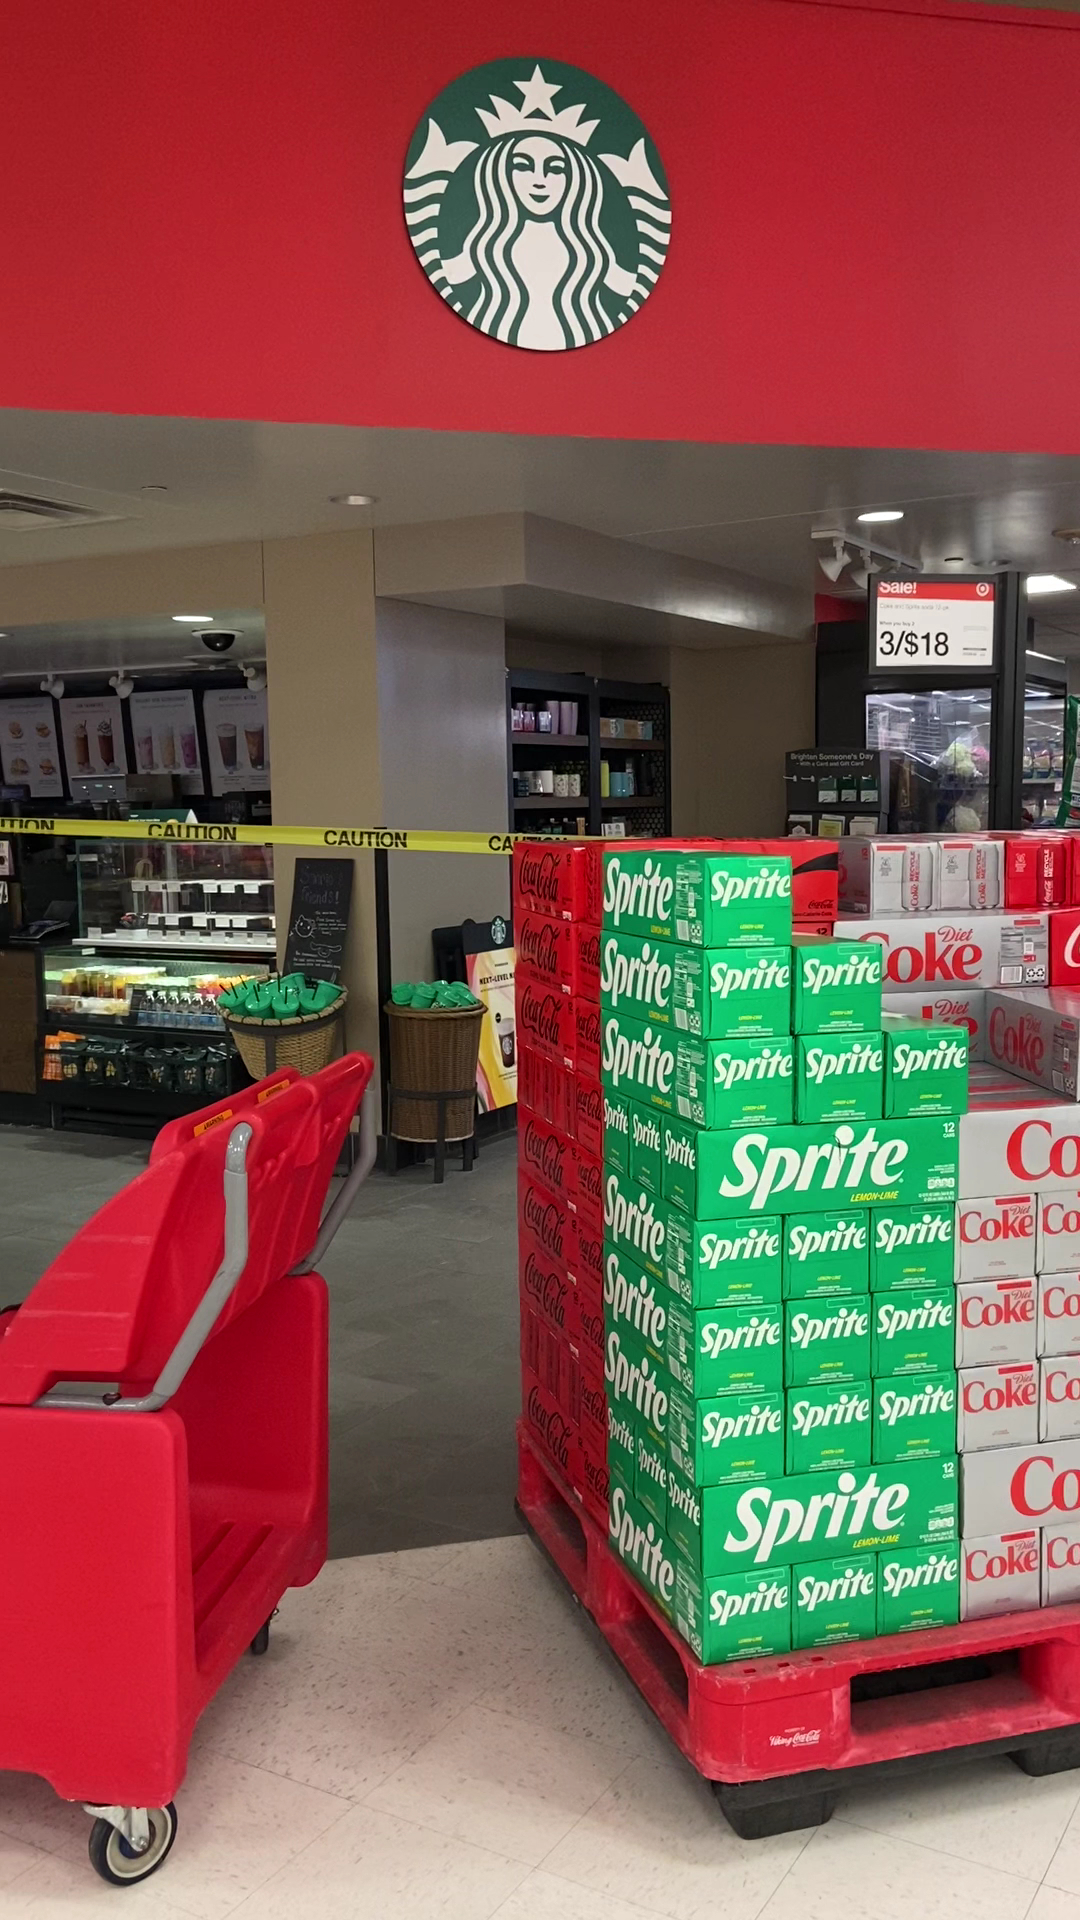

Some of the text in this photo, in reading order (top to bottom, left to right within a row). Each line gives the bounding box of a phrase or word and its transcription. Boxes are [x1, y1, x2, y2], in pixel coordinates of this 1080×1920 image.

[880, 582, 916, 594] Sale!
[880, 630, 949, 657] 3/$18
[148, 824, 236, 840] CAUTION
[324, 830, 407, 848] CAUTION
[603, 858, 673, 926] Sprite
[711, 868, 791, 907] Sprite
[938, 925, 974, 943] Diet
[480, 974, 508, 984] NEXT-LEVEL
[601, 938, 672, 1006] Sprite
[710, 958, 790, 998] Sprite
[803, 955, 880, 994] Sprite
[934, 999, 969, 1016] Diet
[1024, 1012, 1042, 1033] Diet
[602, 1018, 674, 1094] Sprite
[893, 1040, 966, 1079] Sprite
[988, 1006, 1044, 1077] Coke
[714, 1048, 793, 1089] Sprite
[806, 1044, 882, 1084] Sprite
[604, 1098, 629, 1134] Sprite
[943, 1122, 955, 1133] 12
[633, 1120, 660, 1152] Sprite
[665, 1130, 696, 1170] Sprite
[718, 1125, 908, 1209] Sprite
[850, 1190, 899, 1202] LEMON-LIME
[1010, 1205, 1031, 1216] Diet
[604, 1174, 665, 1262] Sprite
[875, 1214, 951, 1253] Sprite
[960, 1208, 1033, 1243] Coke
[699, 1228, 778, 1269] Sprite
[788, 1221, 866, 1261] Sprite
[604, 1253, 666, 1348] Sprite
[962, 1294, 1035, 1329] Coke
[1011, 1289, 1032, 1300] Diet
[700, 1317, 780, 1359] Sprite
[790, 1308, 868, 1348] Sprite
[877, 1300, 952, 1339] Sprite
[604, 1331, 668, 1432] Sprite
[963, 1378, 1036, 1413] Coke
[1013, 1374, 1033, 1385] Diet
[792, 1394, 869, 1436] Sprite
[879, 1385, 954, 1426] Sprite
[608, 1407, 634, 1454] Sprite
[702, 1405, 781, 1448] Sprite
[638, 1438, 666, 1487] Sprite
[942, 1462, 954, 1473] 12
[668, 1472, 700, 1526] Sprite
[723, 1472, 910, 1563] Sprite
[610, 1488, 674, 1602] Sprite
[853, 1534, 900, 1548] LEMON-LIME
[1015, 1540, 1036, 1551] Diet
[883, 1555, 957, 1597] Sprite
[966, 1546, 1038, 1582] Coke
[709, 1582, 788, 1625] Sprite
[798, 1569, 874, 1611] Sprite
[793, 1730, 821, 1747] Coca-Cola
